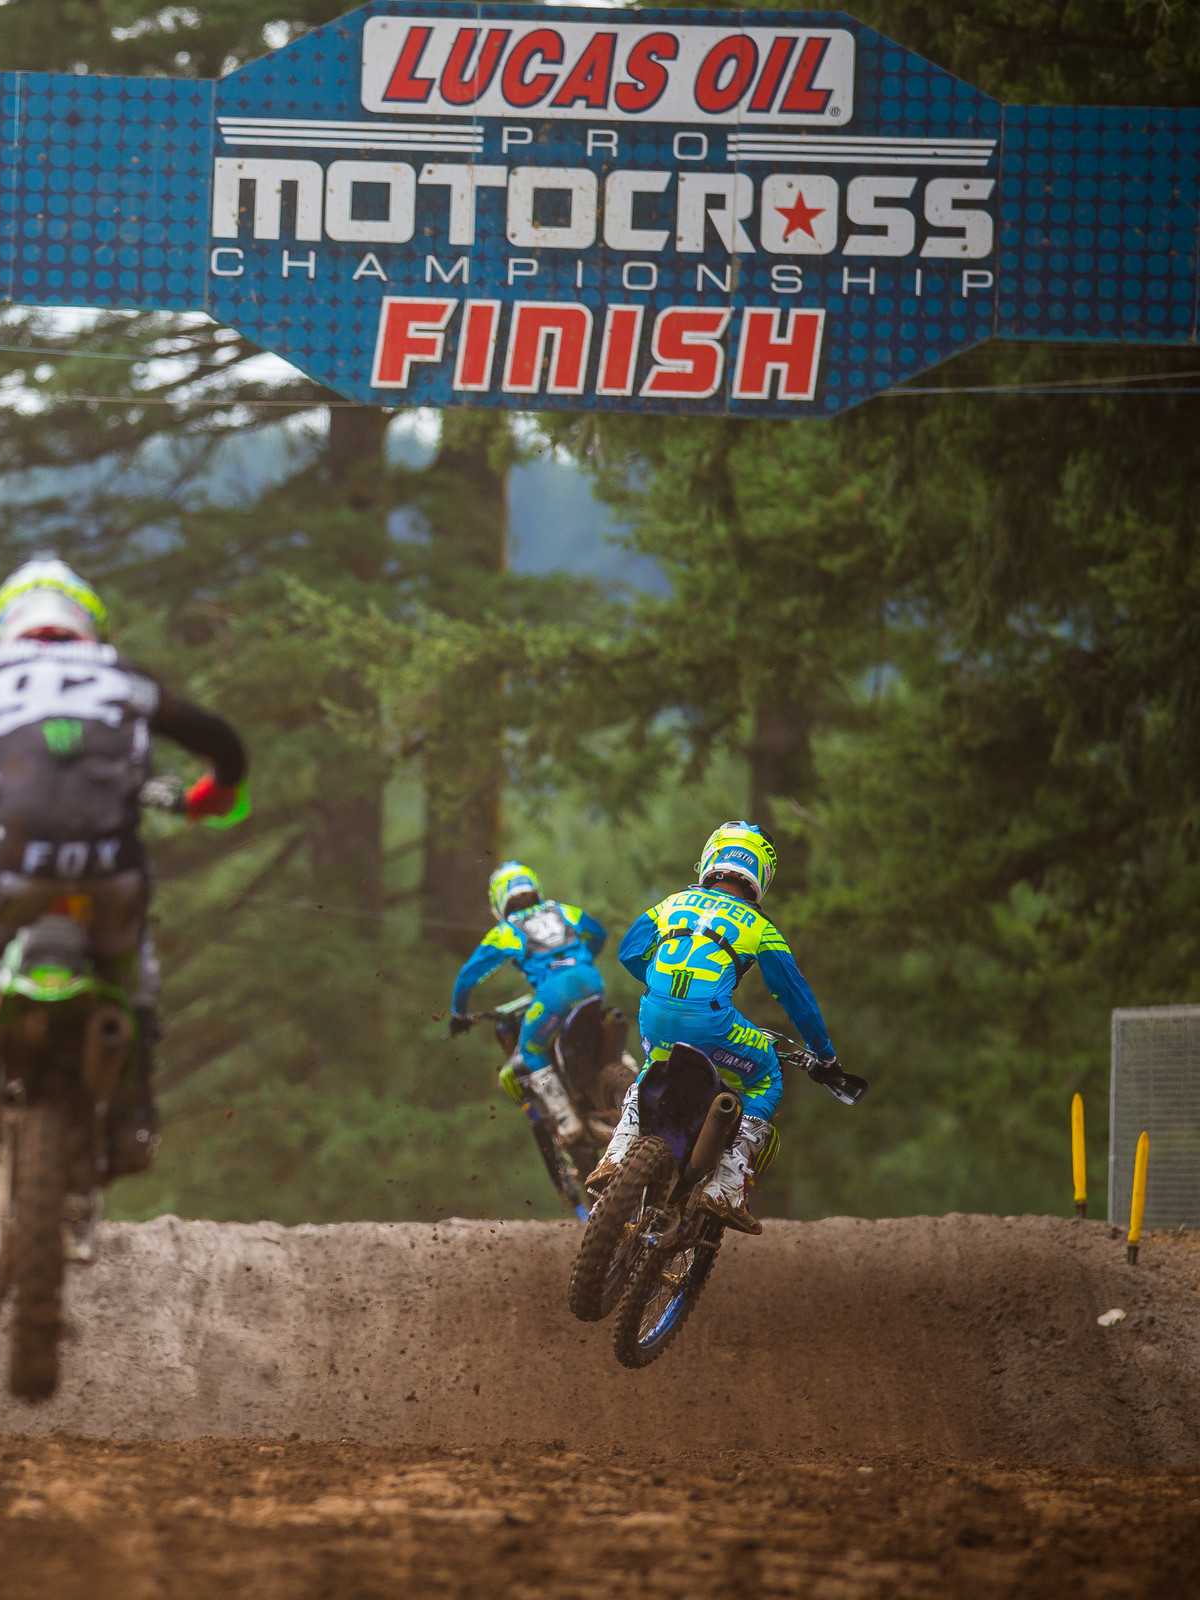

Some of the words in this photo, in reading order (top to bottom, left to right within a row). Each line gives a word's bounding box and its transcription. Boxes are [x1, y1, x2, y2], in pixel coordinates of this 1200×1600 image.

[382, 26, 678, 113] LUCAS
[694, 35, 834, 115] OIL
[501, 126, 710, 161] PRO
[211, 157, 996, 258] MOTOCROSS
[209, 246, 994, 298] CHAMPIONSHIP
[374, 297, 826, 400] FINISH
[723, 849, 756, 867] JUSTIN
[672, 893, 757, 929] COOPER
[658, 909, 740, 975] 32
[726, 1022, 770, 1053] THOR
[721, 1053, 754, 1074] YAMAHA
